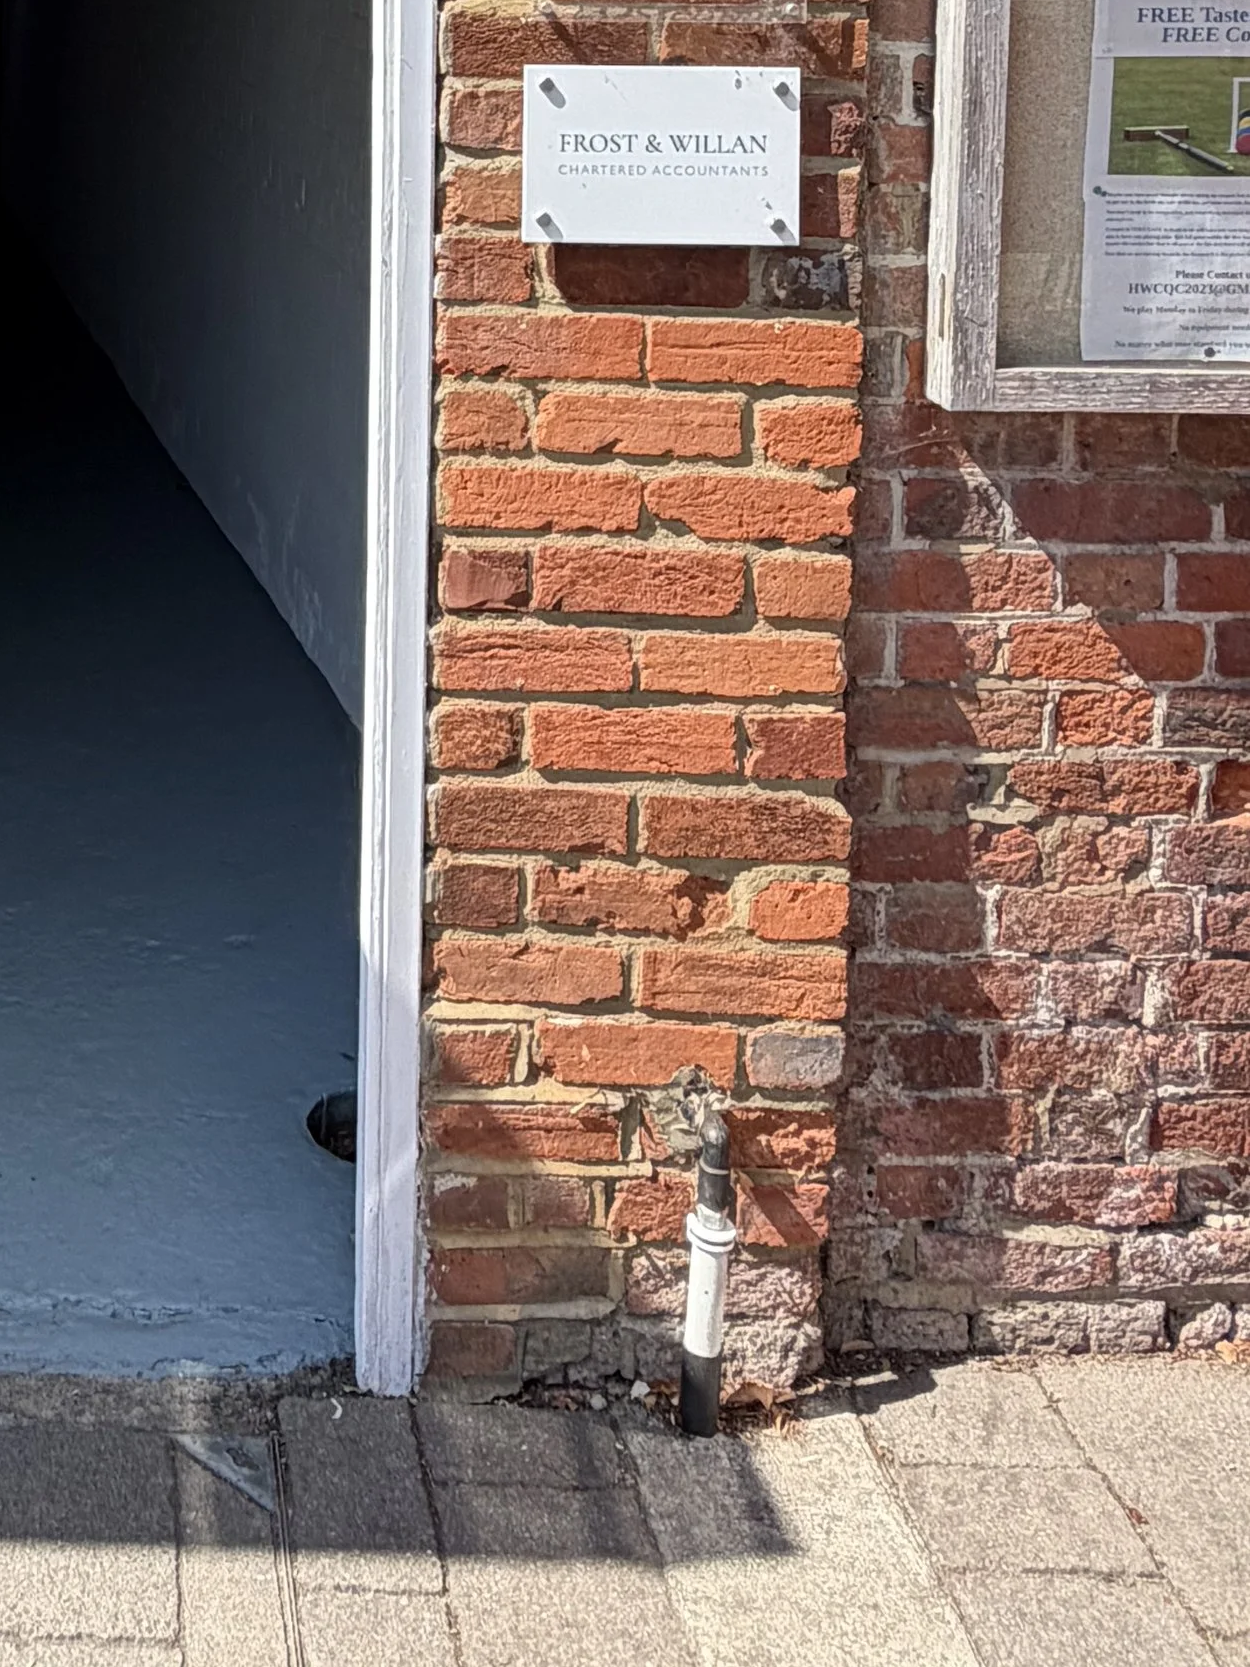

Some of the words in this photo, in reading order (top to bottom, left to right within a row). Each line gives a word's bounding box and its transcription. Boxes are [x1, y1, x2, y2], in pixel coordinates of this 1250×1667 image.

[1137, 7, 1195, 23] FREE
[1162, 26, 1220, 43] FREE
[559, 133, 638, 153] FROST
[645, 134, 664, 154] &
[668, 133, 768, 154] WILLAN
[558, 164, 647, 176] CHARTERED
[652, 164, 769, 177] ACCOUNTANTS
[1175, 270, 1204, 279] Please
[1207, 270, 1243, 279] Contact
